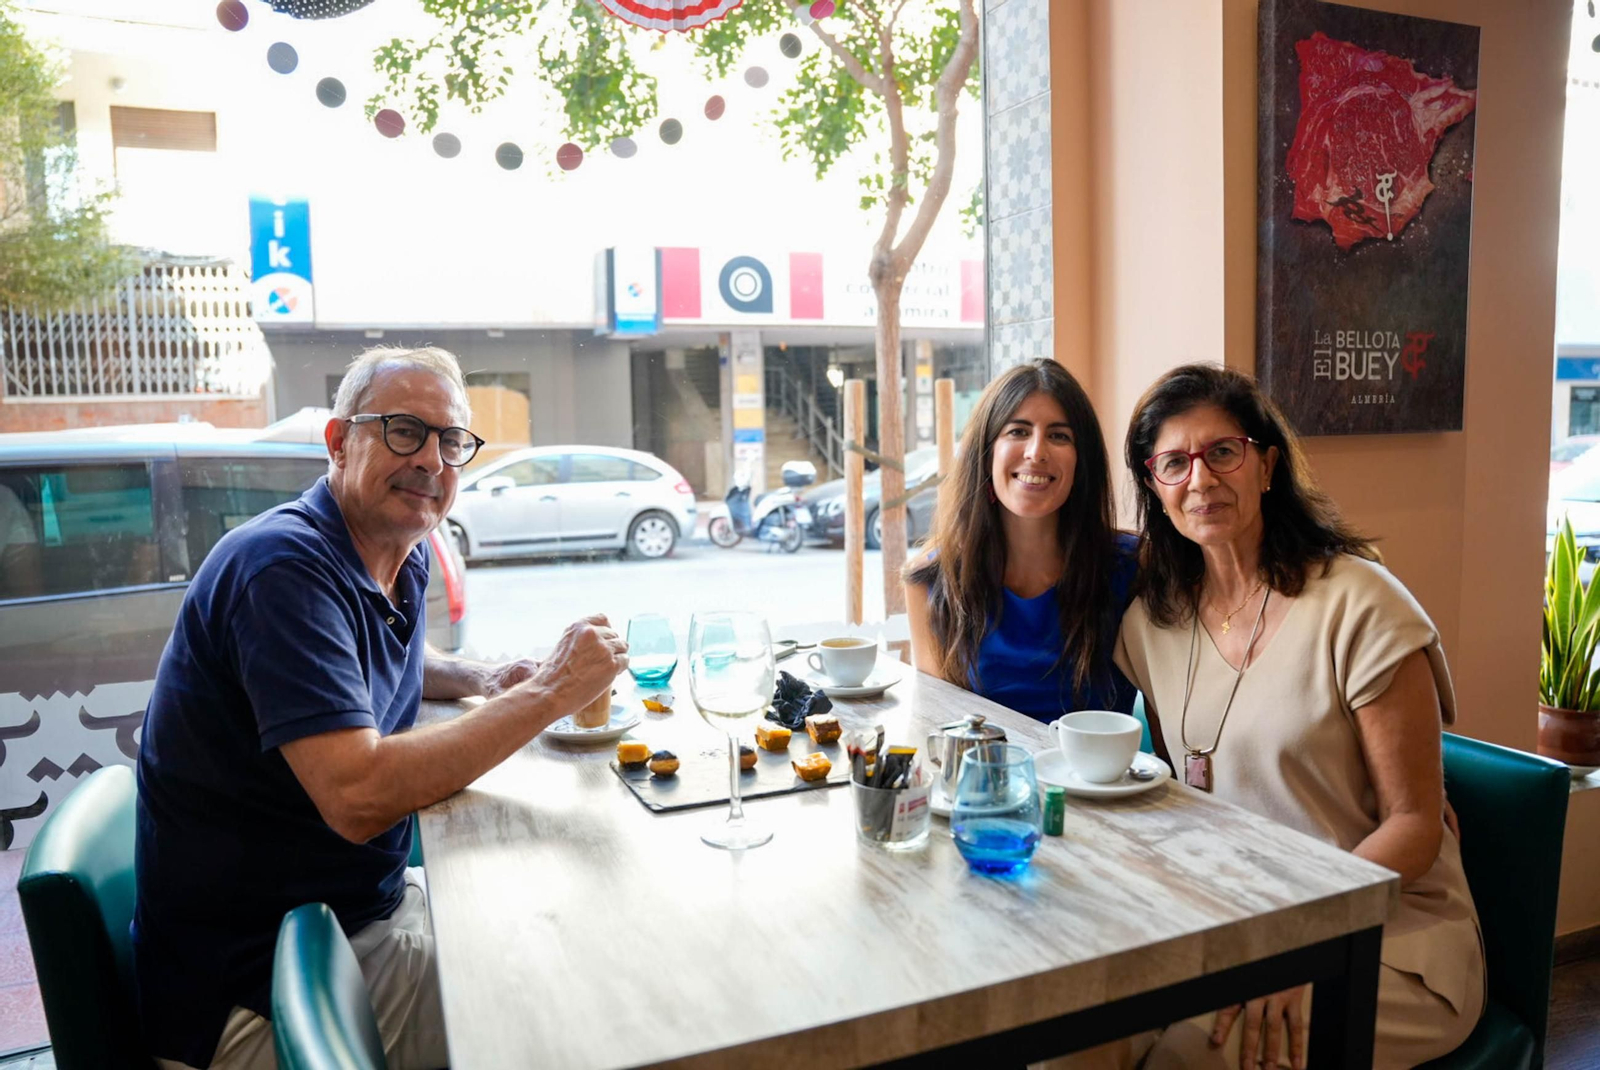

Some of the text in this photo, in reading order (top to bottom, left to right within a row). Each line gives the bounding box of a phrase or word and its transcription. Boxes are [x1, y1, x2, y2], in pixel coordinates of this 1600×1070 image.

[1314, 330, 1400, 349] La BELLOTA
[1313, 347, 1400, 380] El BUEY
